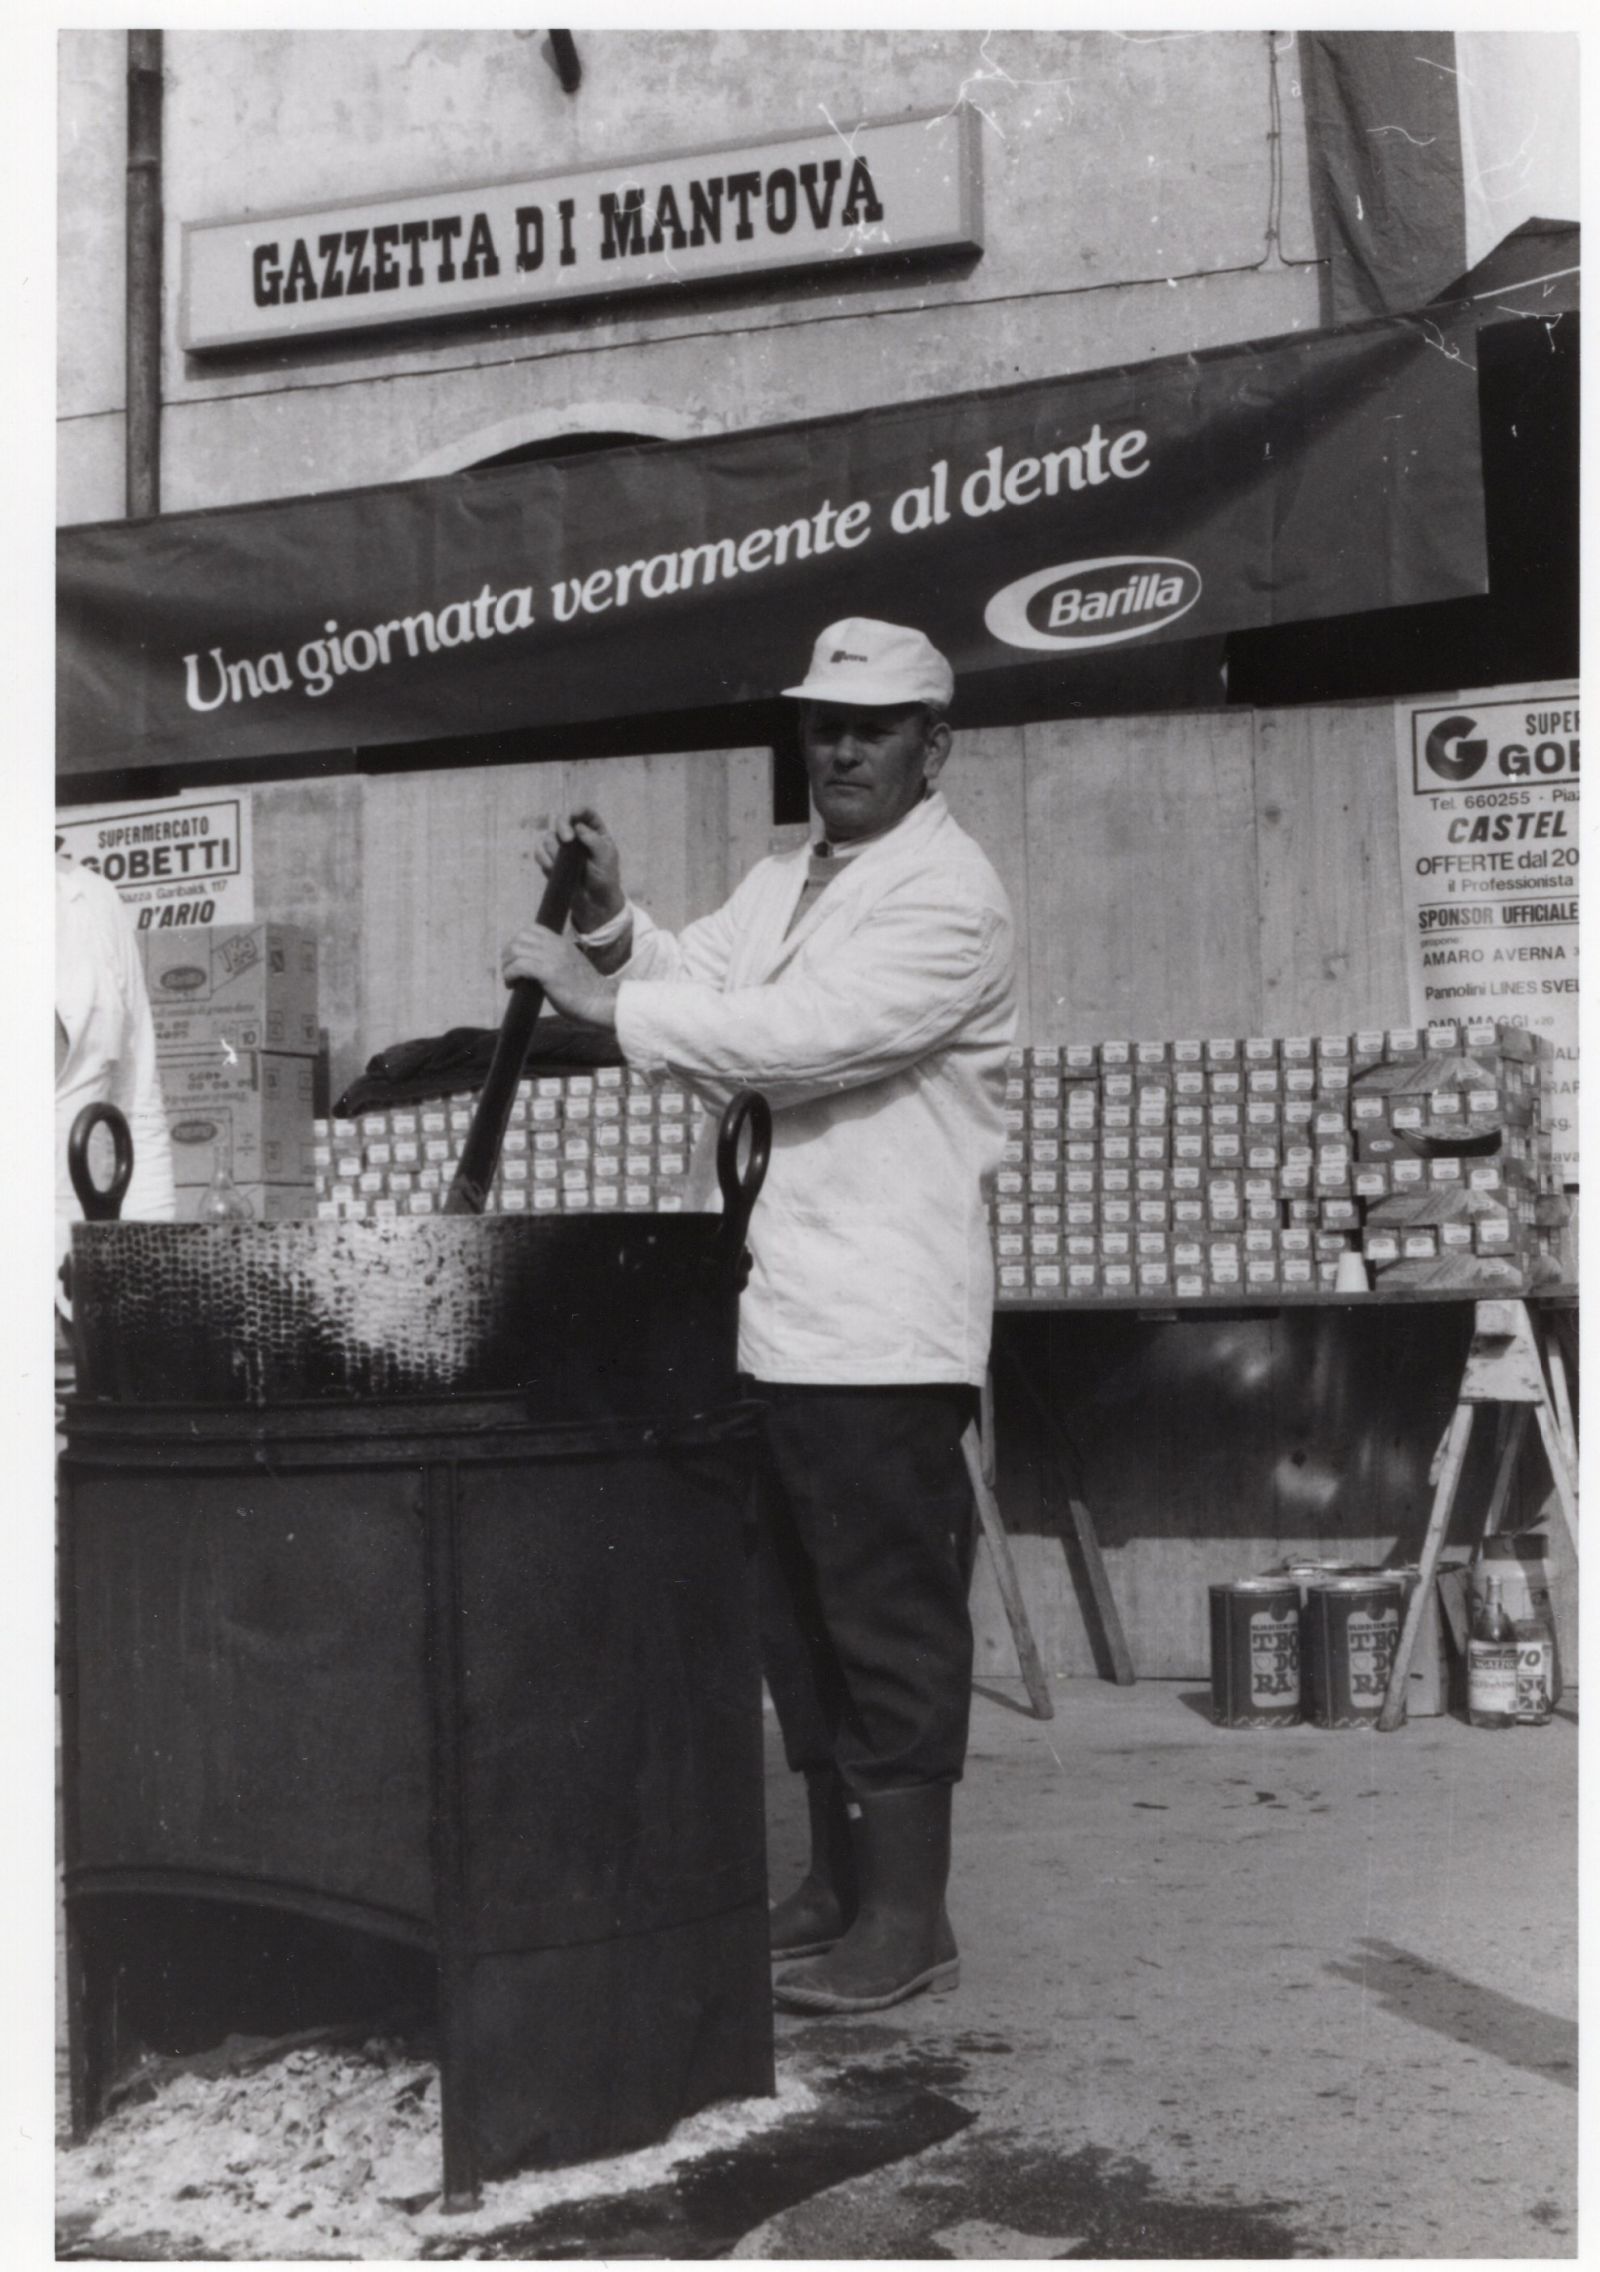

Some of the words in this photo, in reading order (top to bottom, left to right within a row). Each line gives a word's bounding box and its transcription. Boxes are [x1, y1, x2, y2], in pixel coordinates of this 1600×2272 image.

[253, 213, 499, 307] GAZZETTA
[516, 199, 576, 273] DI
[600, 156, 883, 260] MANTOVA
[183, 647, 292, 711] Una
[297, 583, 535, 697] giornata
[551, 499, 871, 622] veramente
[891, 460, 950, 533] al
[961, 424, 1150, 517] dente
[1048, 573, 1184, 627] Barilla
[1464, 791, 1531, 809] 660255
[98, 816, 209, 849] SUPERMERCATO
[1447, 810, 1567, 844] CASTEL
[1416, 851, 1514, 875] OFFERTE
[1518, 849, 1547, 869] dal
[1461, 874, 1574, 892] Professionista
[137, 900, 215, 930] D'ARIO
[1418, 907, 1493, 929] SPONSOR
[1502, 902, 1579, 924] UFFICIALE
[1423, 949, 1485, 967] AMARO
[1493, 946, 1566, 962] AVERNA
[1425, 981, 1487, 1000] Pannolini
[1490, 980, 1538, 996] LINES
